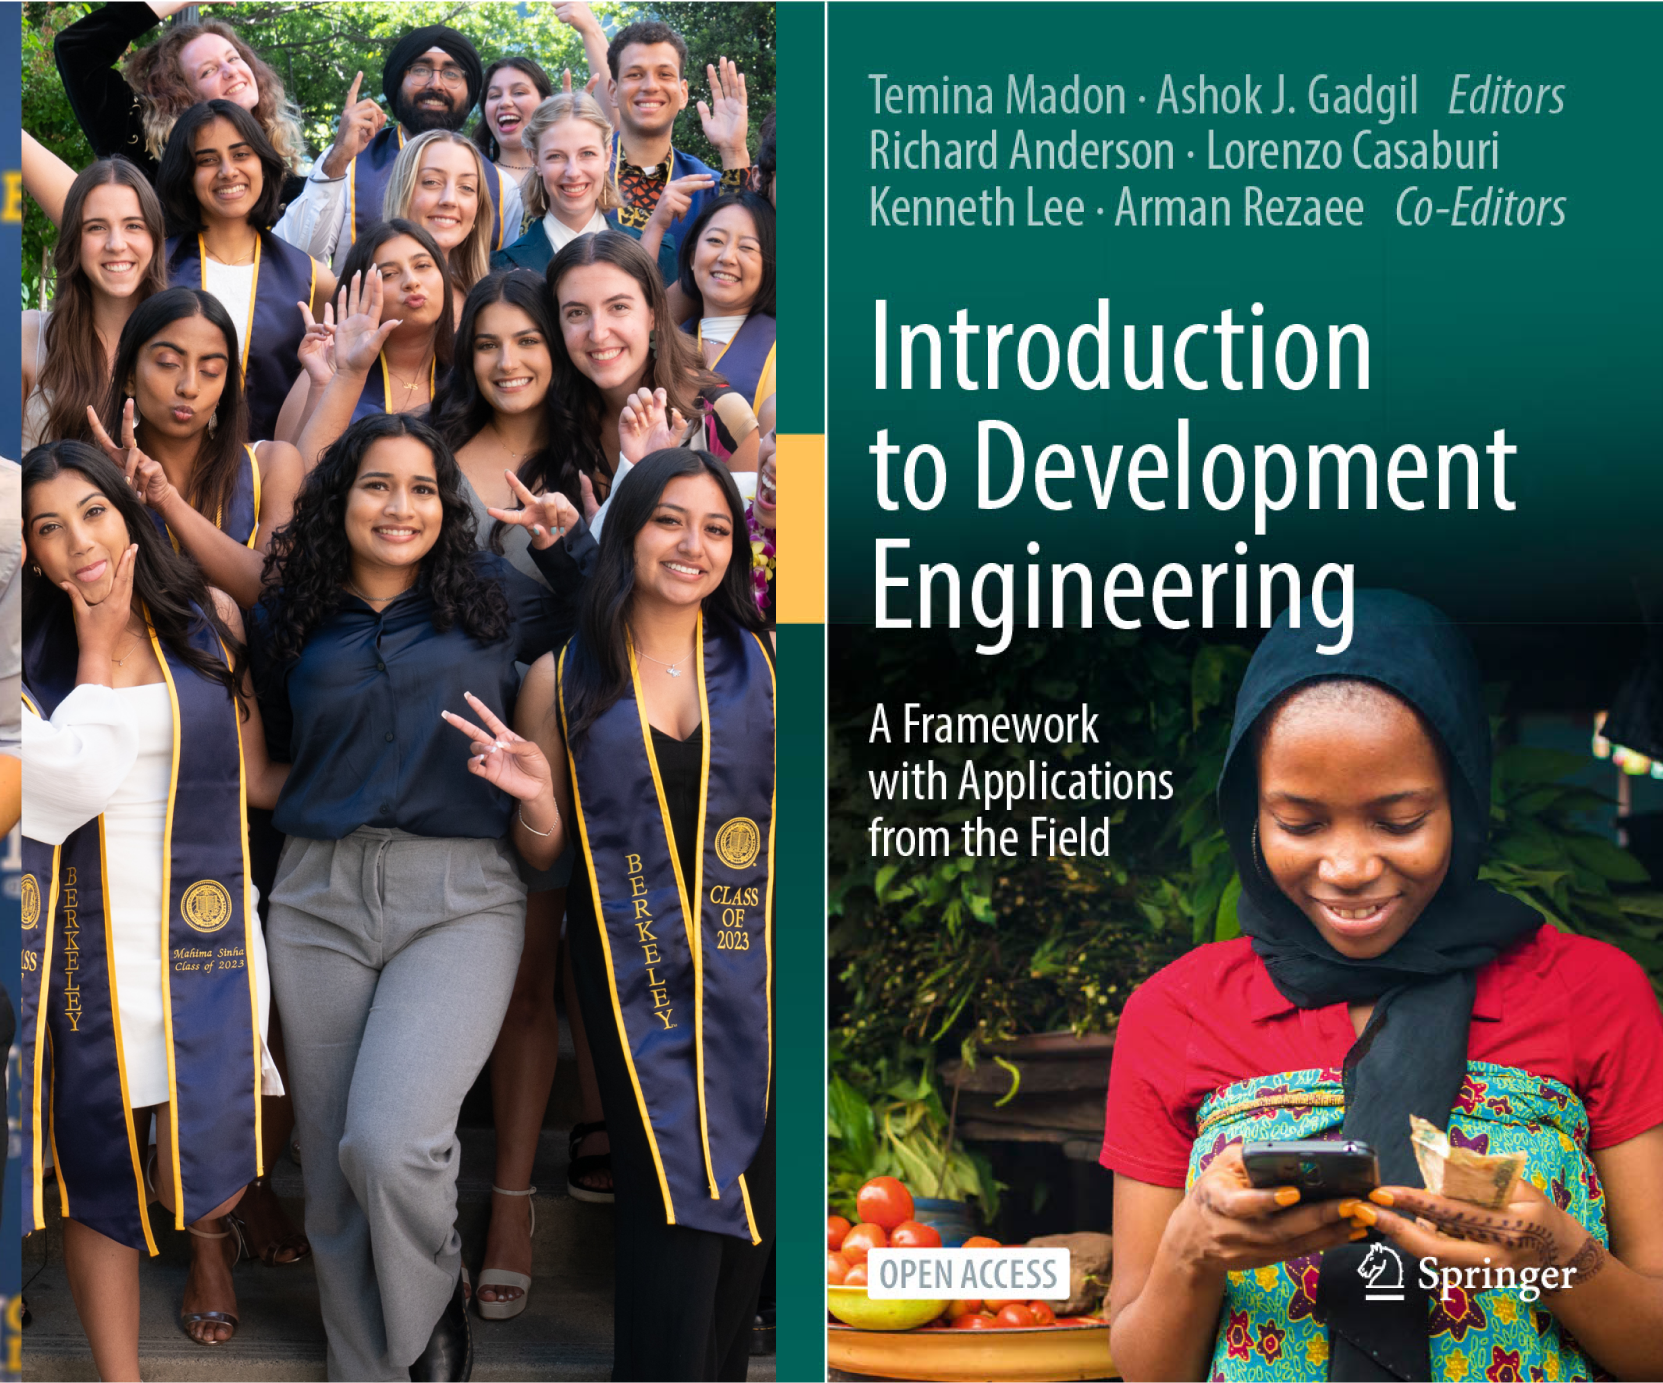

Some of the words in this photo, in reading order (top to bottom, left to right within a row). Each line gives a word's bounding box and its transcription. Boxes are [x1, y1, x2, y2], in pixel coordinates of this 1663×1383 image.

[868, 74, 992, 114] Temina
[1007, 74, 1124, 114] Madon
[1157, 74, 1262, 114] Ashok
[1272, 74, 1294, 114] J.
[1309, 74, 1416, 124] Gadgil
[1449, 74, 1565, 114] Editors
[872, 130, 996, 170] Richard
[1009, 130, 1173, 170] Anderson
[1209, 130, 1342, 170] Lorenzo
[1354, 130, 1498, 170] Casaburi
[871, 186, 1014, 226] Kenneth
[1028, 186, 1084, 226] Lee
[1115, 186, 1230, 226] Arman
[1246, 186, 1363, 226] Rezaee
[1397, 186, 1567, 226] Co-Editors
[876, 298, 1369, 390] Introduction
[869, 429, 946, 511] to
[979, 419, 1516, 535] Development
[876, 539, 1354, 655] Engineering
[869, 704, 891, 742] A
[906, 704, 1098, 742] Framework
[869, 760, 946, 799] with
[959, 760, 1173, 810] Applications
[869, 817, 949, 856] from
[962, 817, 1017, 856] the
[1033, 817, 1108, 856] Field
[710, 885, 759, 906] CLASS
[722, 908, 745, 928] OF
[63, 866, 82, 1032] BERKELEY
[173, 947, 213, 959] Mahima
[217, 946, 245, 958] Sinha
[624, 853, 674, 1030] BERKELEY
[717, 930, 750, 951] 2023
[174, 960, 201, 971] Class
[203, 960, 216, 974] of
[218, 959, 245, 970] 2023
[880, 1260, 953, 1289] OPEN
[961, 1260, 1058, 1289] ACCESS
[1419, 1257, 1577, 1302] Springer
